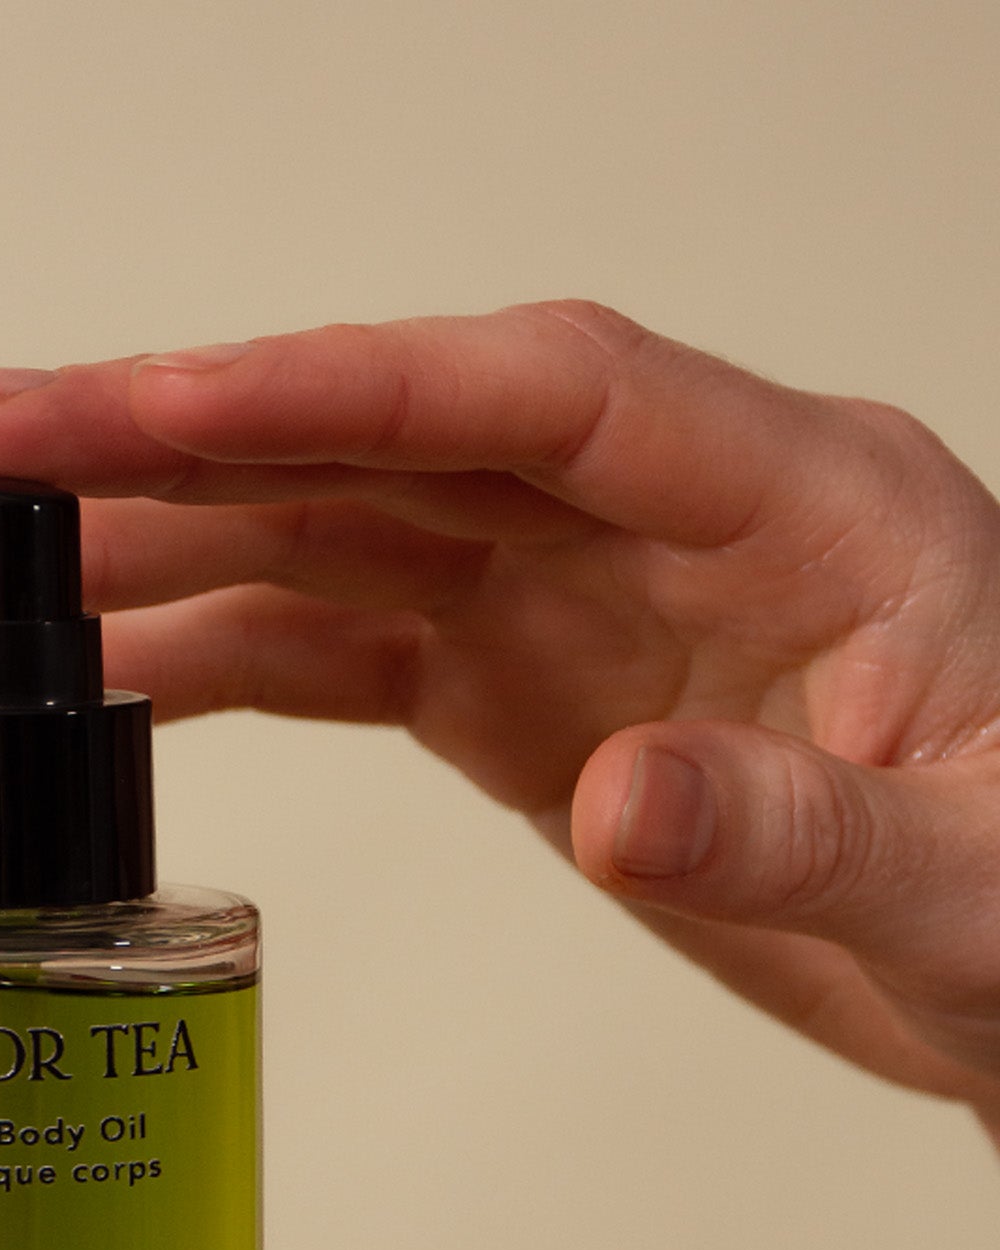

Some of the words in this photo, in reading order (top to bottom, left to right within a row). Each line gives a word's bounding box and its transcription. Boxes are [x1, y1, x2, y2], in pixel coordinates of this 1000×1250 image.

[90, 1019, 198, 1079] TEA
[100, 1112, 147, 1142] Oil
[72, 1157, 162, 1186] corps
